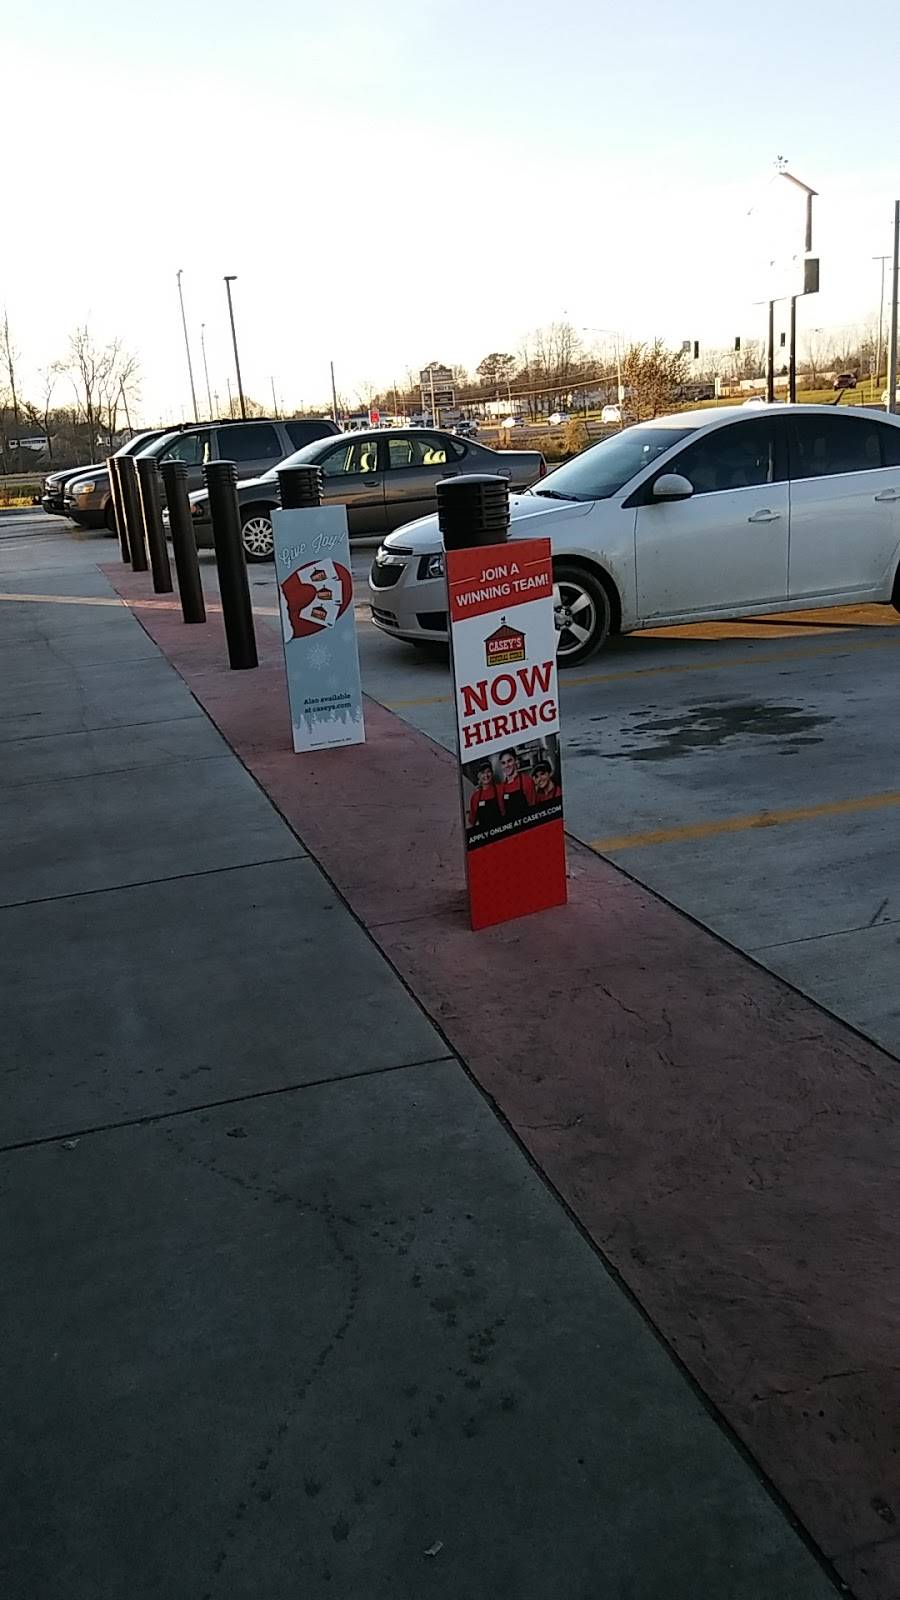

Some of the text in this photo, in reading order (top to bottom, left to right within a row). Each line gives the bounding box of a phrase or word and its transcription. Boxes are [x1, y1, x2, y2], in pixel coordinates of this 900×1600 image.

[279, 532, 345, 568] Give Joy!
[480, 563, 519, 582] JOIN A
[456, 574, 549, 606] WINNING TEAM!
[489, 638, 521, 652] CASEY'S
[320, 693, 351, 703] available
[460, 662, 553, 717] NOW
[313, 703, 352, 712] caseys.com
[462, 700, 556, 748] HIRING
[469, 805, 562, 843] APPLY ONLINE AT CASEYS.COM
